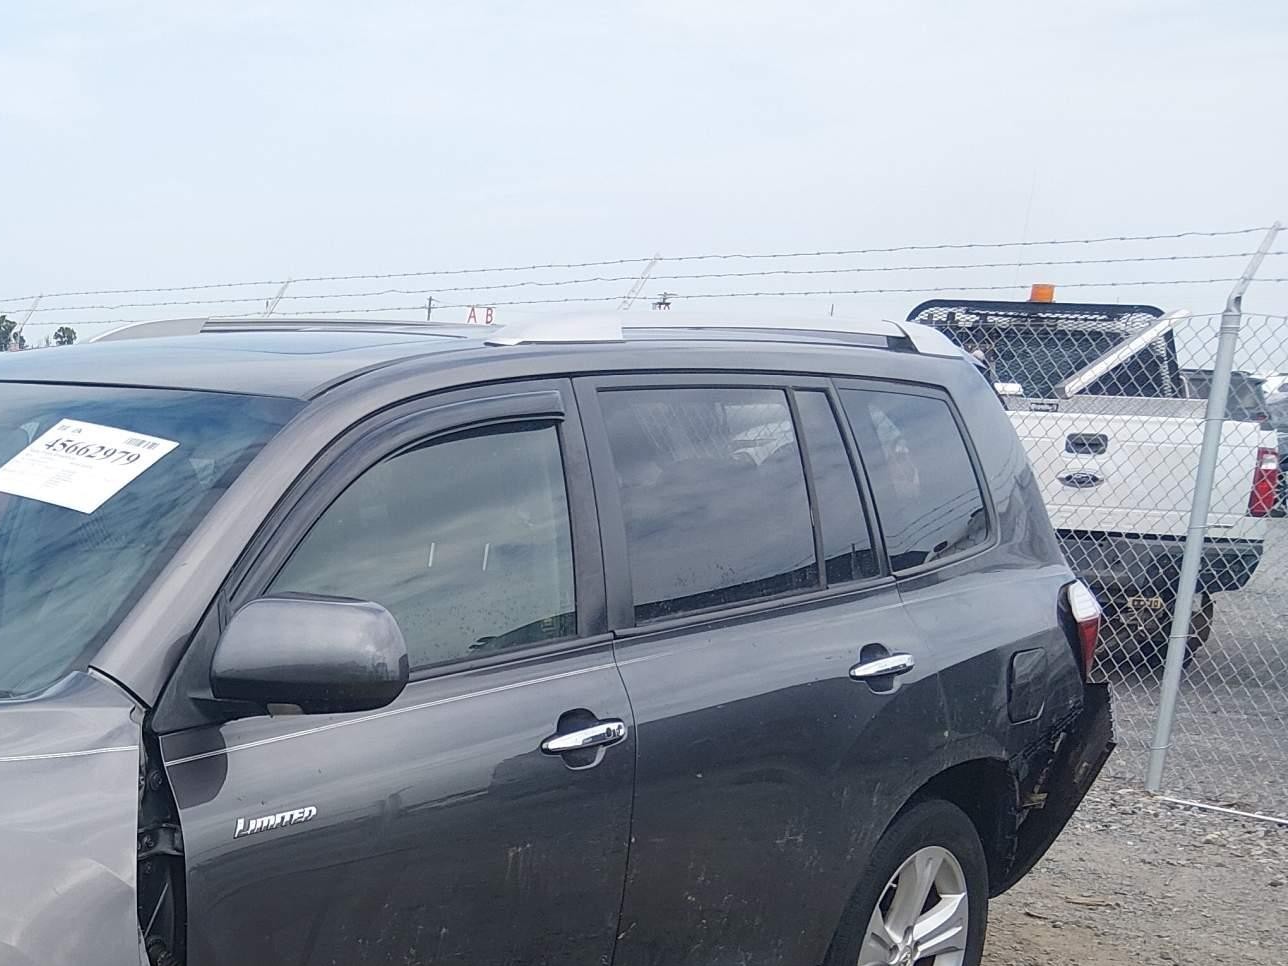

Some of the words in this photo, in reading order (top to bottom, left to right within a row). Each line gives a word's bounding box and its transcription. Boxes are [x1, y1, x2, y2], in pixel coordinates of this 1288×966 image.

[467, 306, 477, 324] A
[485, 307, 493, 324] B
[44, 437, 141, 466] 45662979
